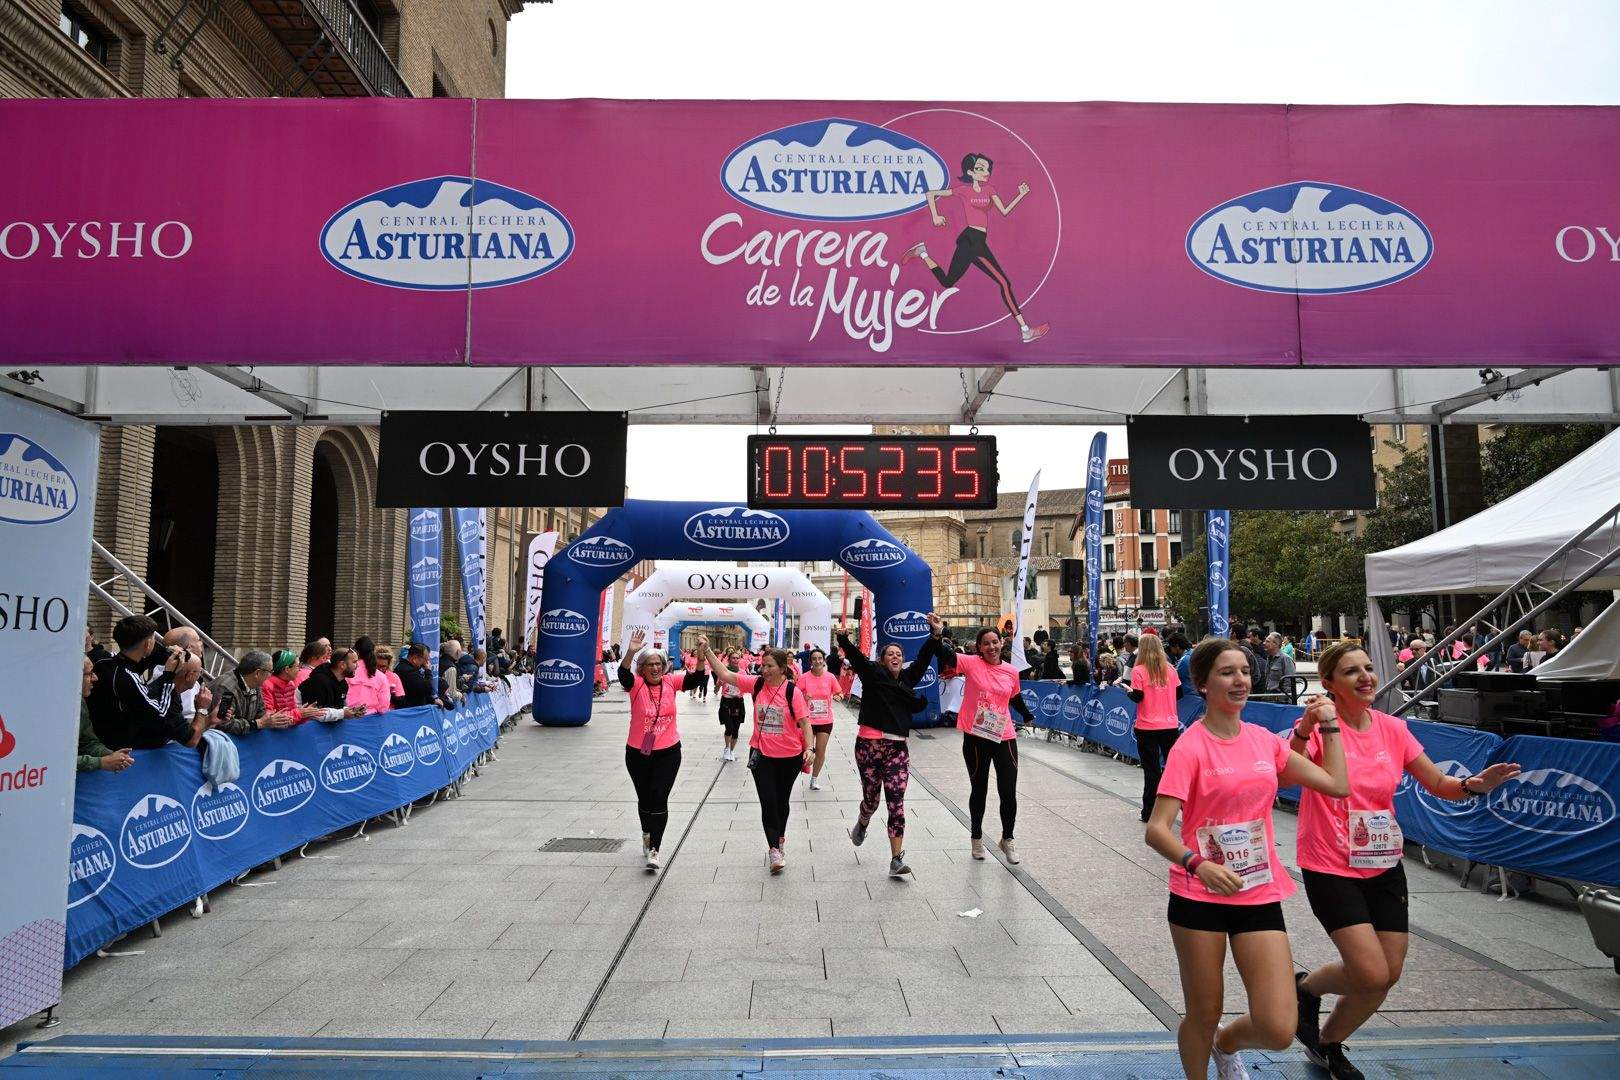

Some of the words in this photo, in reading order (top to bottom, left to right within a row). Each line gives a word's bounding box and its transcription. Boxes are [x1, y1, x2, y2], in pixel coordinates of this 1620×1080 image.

[774, 153, 846, 165] CENTRAL
[852, 154, 925, 165] LECHERA
[739, 155, 930, 195] ASTURIANA
[380, 216, 459, 227] CENTRAL
[466, 215, 547, 226] LECHERA
[1243, 220, 1321, 232] CENTRAL
[1327, 220, 1406, 232] LECHERA
[0, 220, 193, 260] OYSHO
[338, 218, 555, 260] ASTURIANA
[700, 212, 889, 268] Carrera
[1206, 222, 1416, 264] ASTURIANA
[745, 270, 782, 307] de
[788, 268, 815, 308] la
[809, 263, 960, 353] Mujer
[419, 441, 592, 478] OYSHO
[1168, 447, 1338, 482] OYSHO
[24, 468, 66, 485] LECHERA
[692, 520, 782, 540] ASTURIANA
[1116, 512, 1124, 554] HOTEL
[571, 546, 629, 560] ASTURIANA
[846, 551, 902, 562] ASTURIANA
[687, 573, 769, 590] OYSHO
[1118, 559, 1126, 600] TIBUR
[541, 618, 586, 631] ASTURIANA
[887, 622, 930, 633] ASTURIAN
[537, 669, 580, 681] ASTURIANA
[325, 762, 374, 786] ASTURIANA
[257, 778, 313, 808] ASTURIANA
[1492, 787, 1604, 823] ASTURIANA
[196, 800, 247, 830] ASTURIANA
[72, 839, 103, 856] LECHERA
[128, 819, 191, 859] ASTURIANA
[1371, 833, 1389, 842] 016
[1226, 848, 1249, 861] 016
